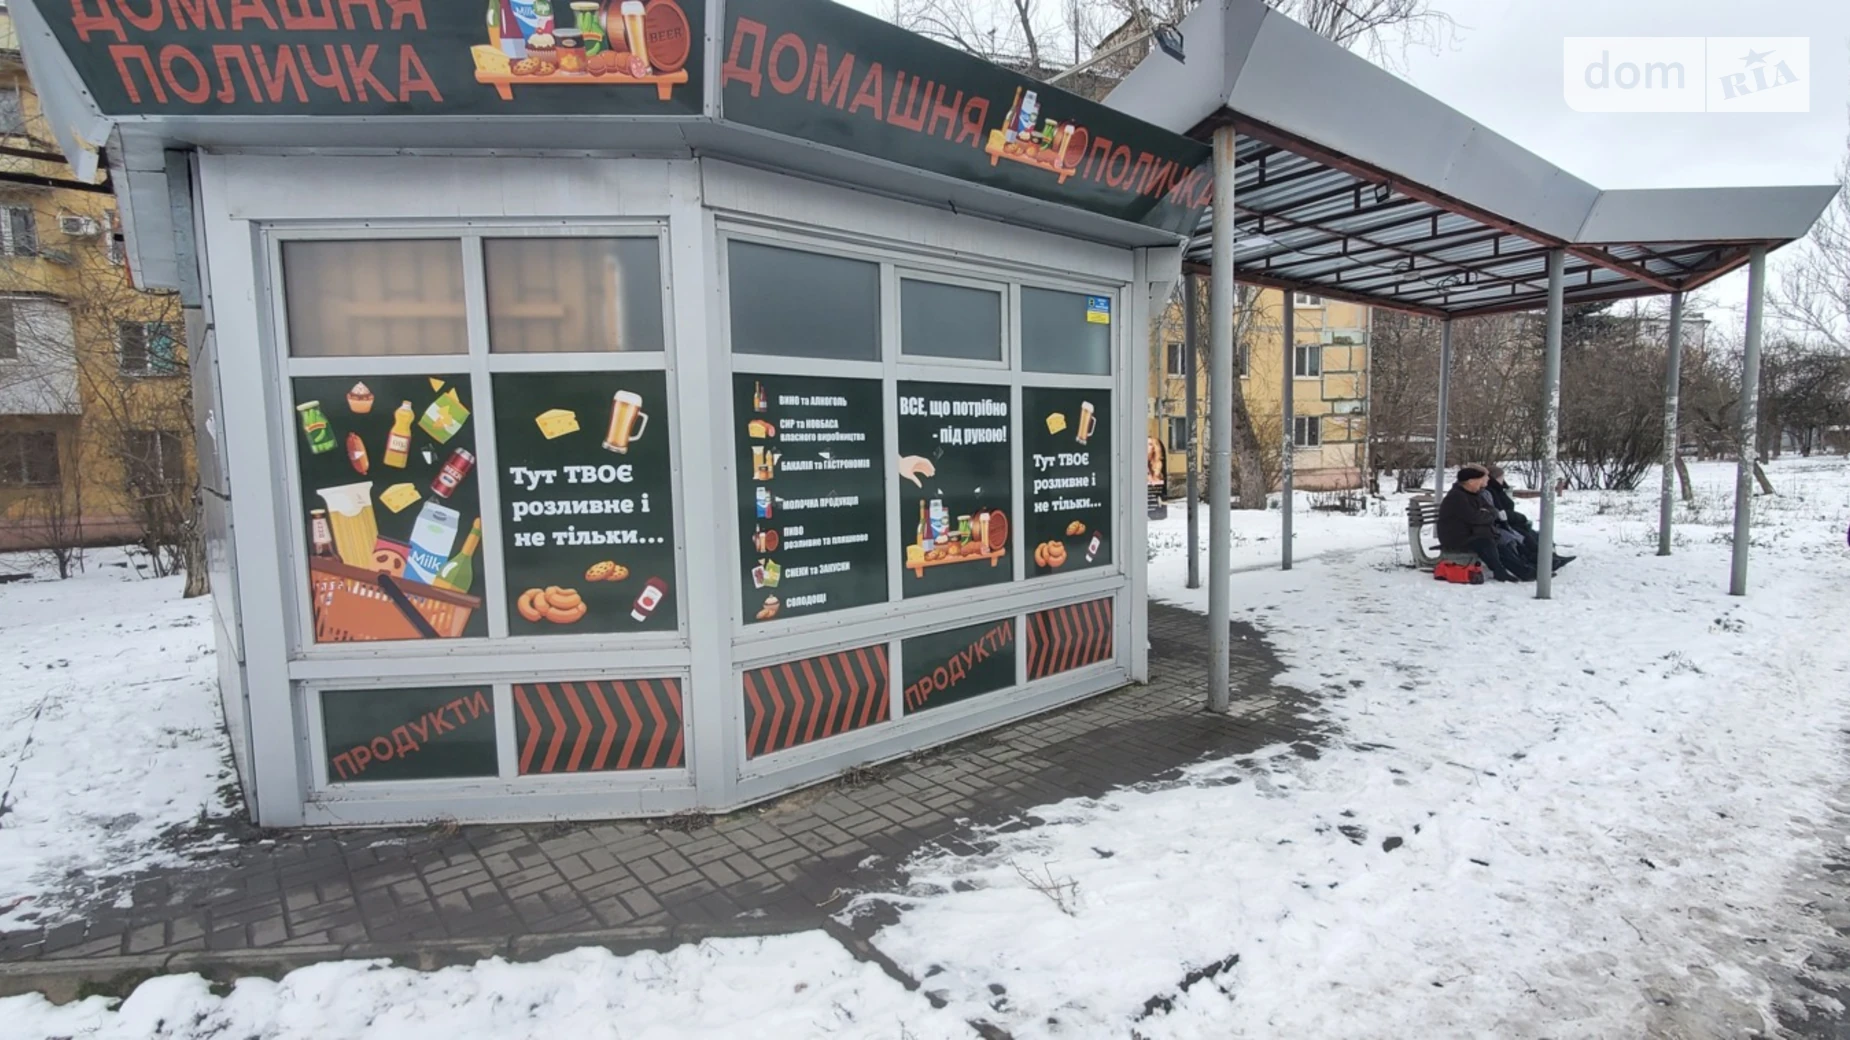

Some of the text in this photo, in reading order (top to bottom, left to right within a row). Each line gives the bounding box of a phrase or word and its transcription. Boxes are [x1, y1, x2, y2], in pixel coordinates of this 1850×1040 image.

[650, 27, 682, 44] BEER
[108, 44, 444, 103] ПОЛИЧКА
[722, 16, 990, 148] ДОМАШНЯ
[779, 395, 847, 407] ВИНО та АЛКОГОЛЬ
[900, 397, 1007, 418] ВСЕ, що потрібно
[780, 419, 839, 429] СИР та КОВБАСА
[940, 425, 963, 445] під
[964, 425, 1007, 444] рукою!
[781, 458, 870, 472] БАКАЛІЯ та ГАСТРОНОМІЯ
[1033, 452, 1090, 472] Тут ТВОЄ
[509, 464, 634, 491] Тут ТВОЄ
[1033, 472, 1096, 495] розливне і
[512, 493, 650, 522] розливне і
[782, 498, 819, 510] МОЛОЧНА
[1034, 501, 1049, 513] не
[514, 525, 664, 547] не тільки...
[783, 525, 804, 537] ПИВО
[411, 550, 441, 571] Milk
[809, 566, 818, 575] та
[819, 561, 851, 575] ЗАКУСКИ
[786, 593, 827, 608] СОЛОДОЩІ
[905, 620, 1014, 712] ПРОДУКТИ
[332, 690, 492, 780] ПРОДУКТИ
